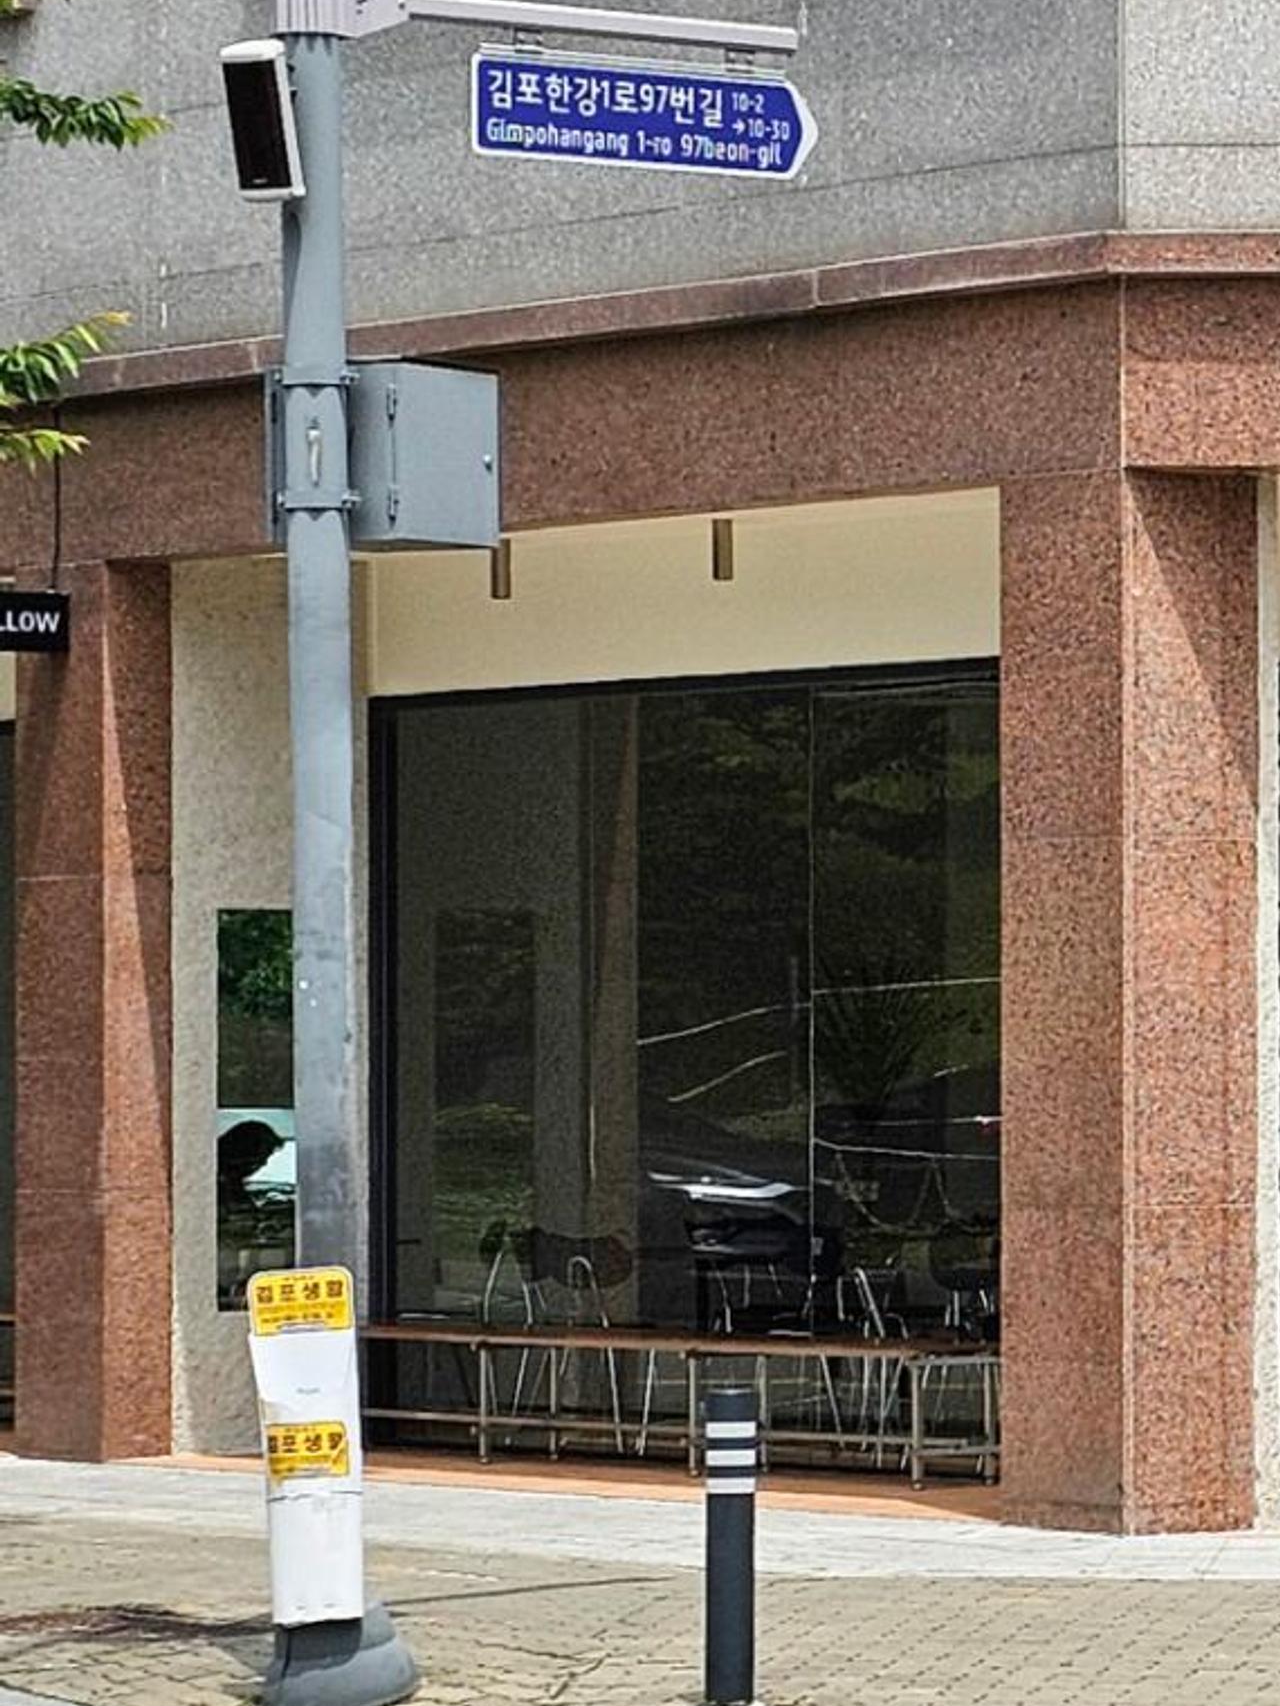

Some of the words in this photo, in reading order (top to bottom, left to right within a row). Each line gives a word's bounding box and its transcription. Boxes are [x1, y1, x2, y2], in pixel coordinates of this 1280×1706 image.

[487, 69, 724, 129] 김포한강1로97번길
[731, 92, 764, 114] 10-2
[486, 117, 629, 156] Gimpohangang
[637, 130, 671, 155] 1-ro
[680, 134, 783, 169] 97beon-gil
[747, 119, 791, 141] 10-30
